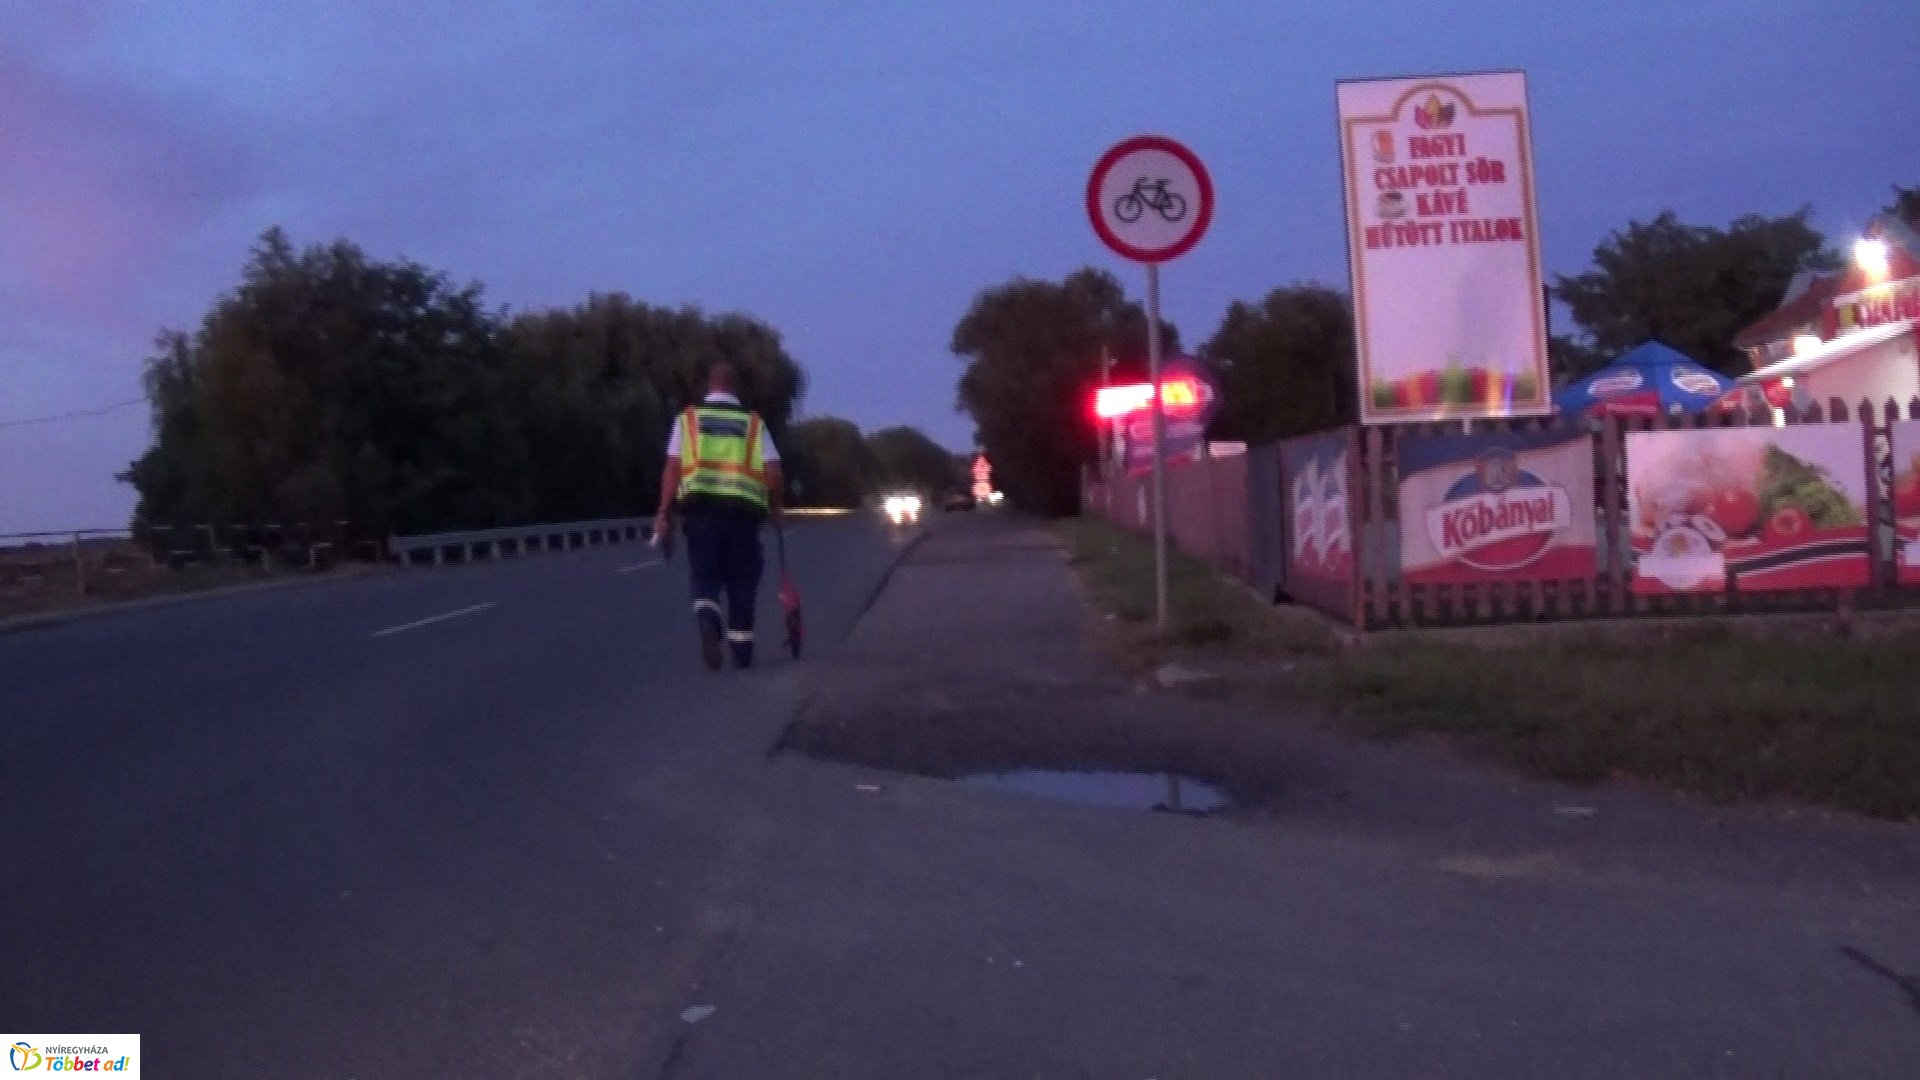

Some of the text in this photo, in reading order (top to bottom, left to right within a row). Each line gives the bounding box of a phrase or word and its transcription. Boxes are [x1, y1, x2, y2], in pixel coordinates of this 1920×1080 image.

[1374, 157, 1505, 189] CSAPOLT SÖR
[1417, 188, 1469, 216] KÁVÉ
[1450, 218, 1523, 243] ITALOK
